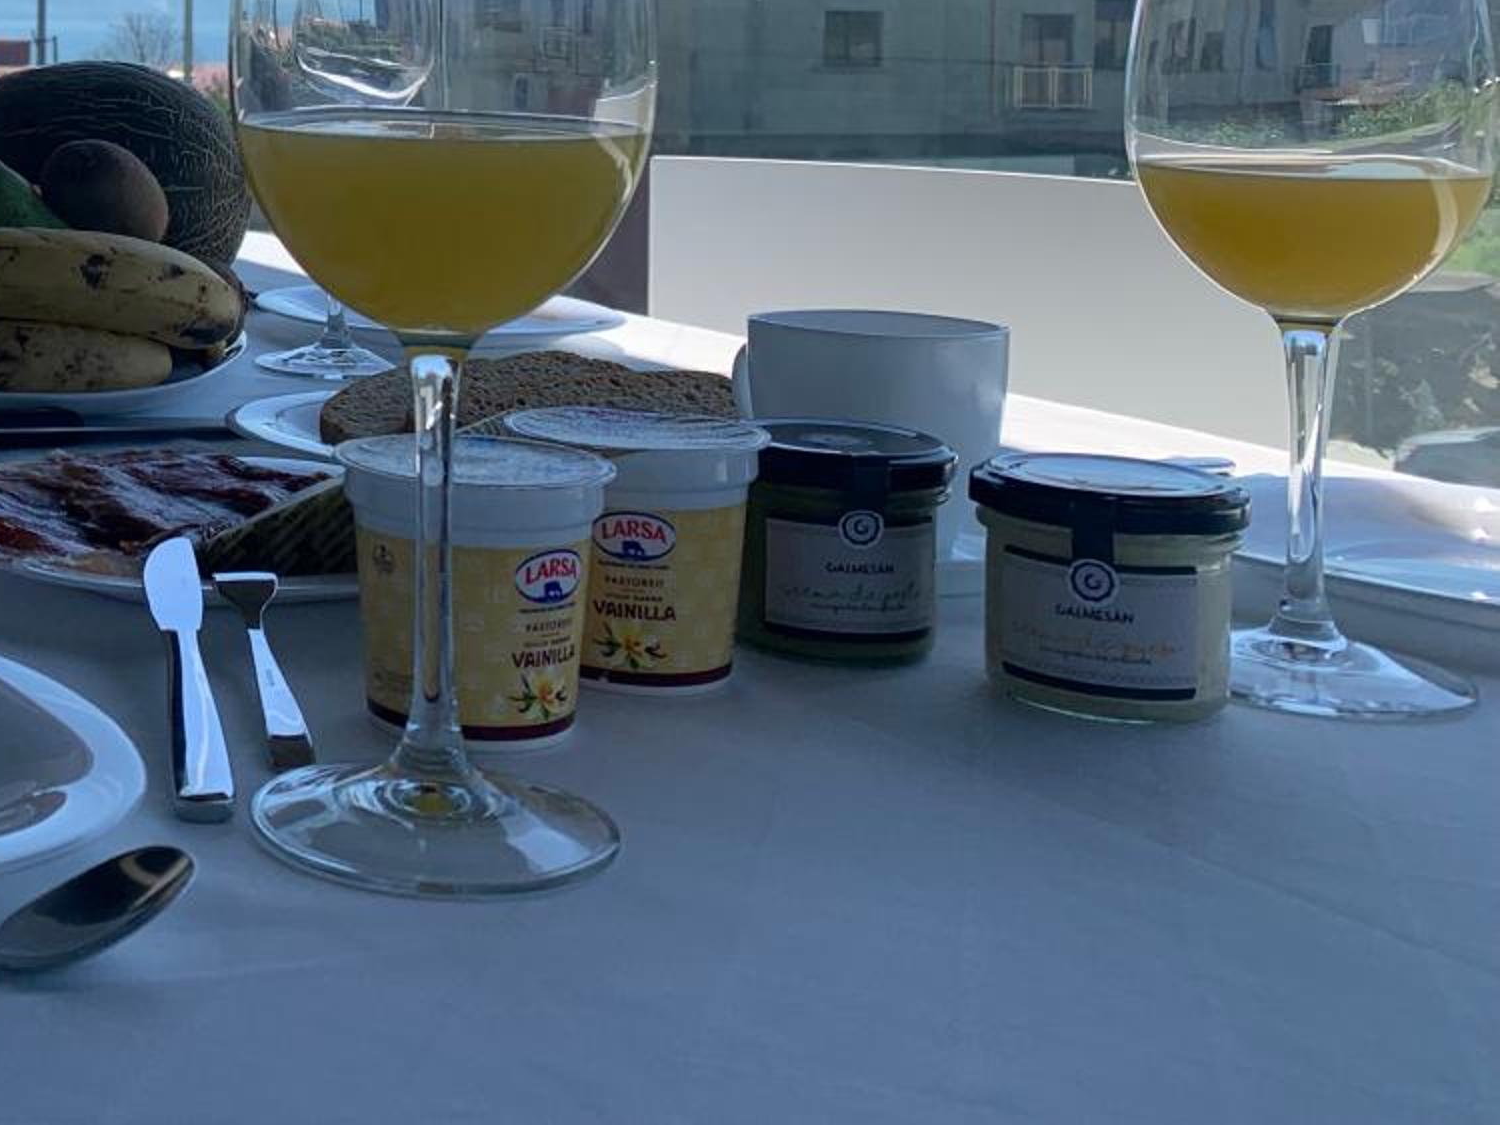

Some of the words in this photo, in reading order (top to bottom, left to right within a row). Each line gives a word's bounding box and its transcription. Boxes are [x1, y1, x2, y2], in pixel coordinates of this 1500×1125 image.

[602, 520, 667, 545] LARSA
[525, 558, 577, 584] LARSA
[593, 599, 677, 621] VAINILLA
[511, 644, 575, 668] VAINILLA
